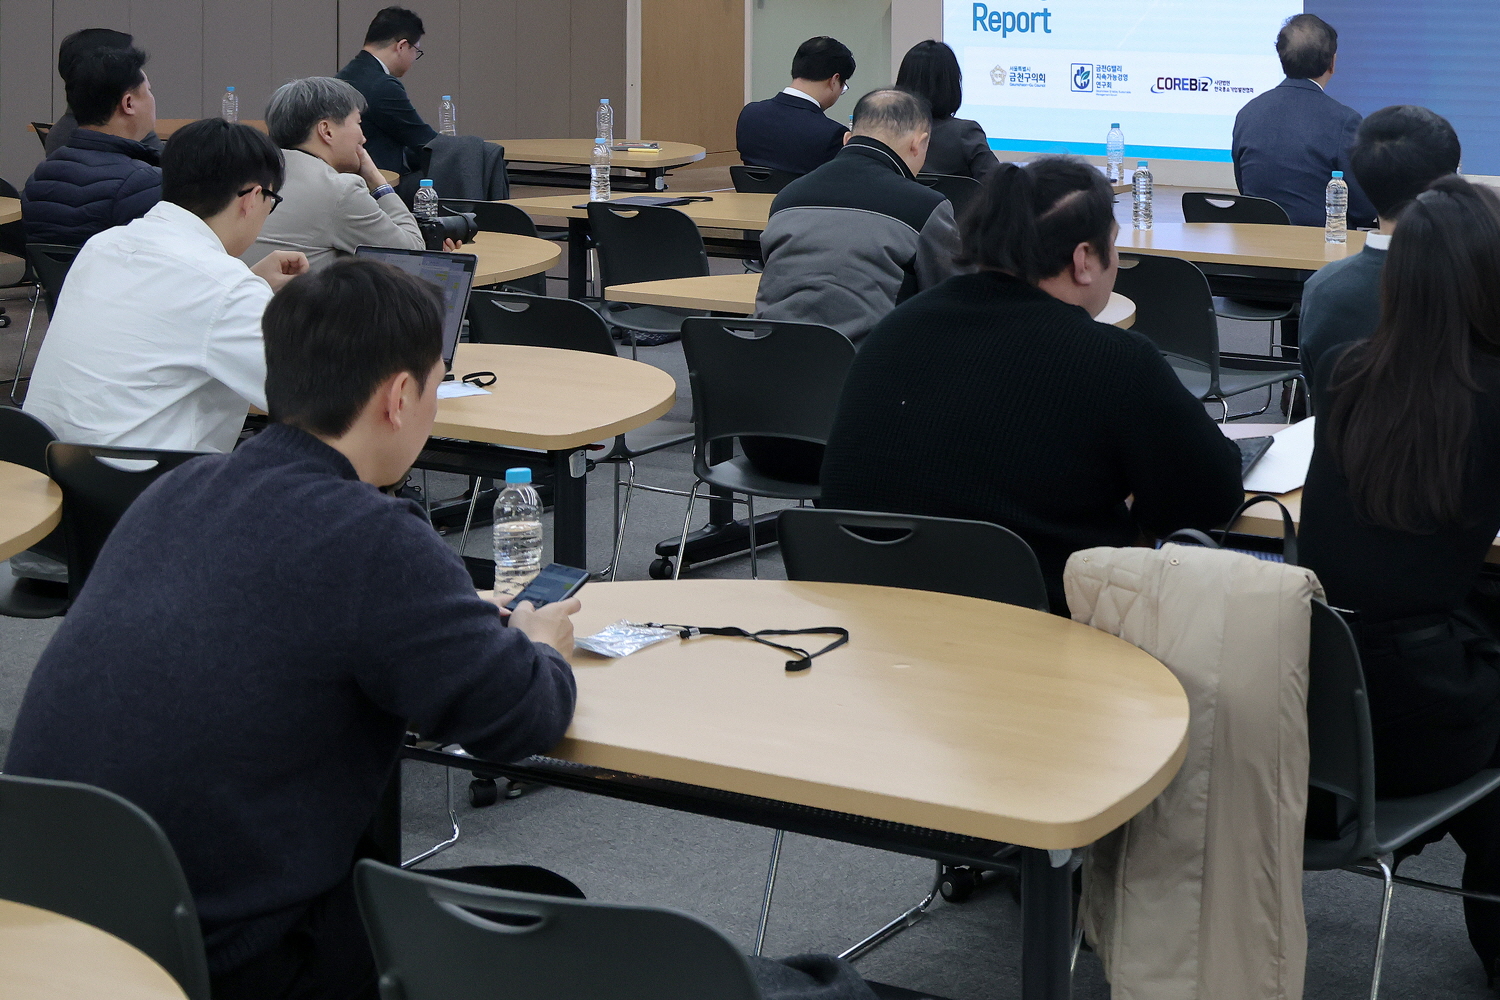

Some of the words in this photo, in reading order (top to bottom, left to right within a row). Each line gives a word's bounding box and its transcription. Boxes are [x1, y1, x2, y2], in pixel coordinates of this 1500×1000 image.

[972, 2, 1052, 38] Report
[1009, 73, 1046, 83] 금천구의회
[1156, 77, 1209, 92] COREBiz
